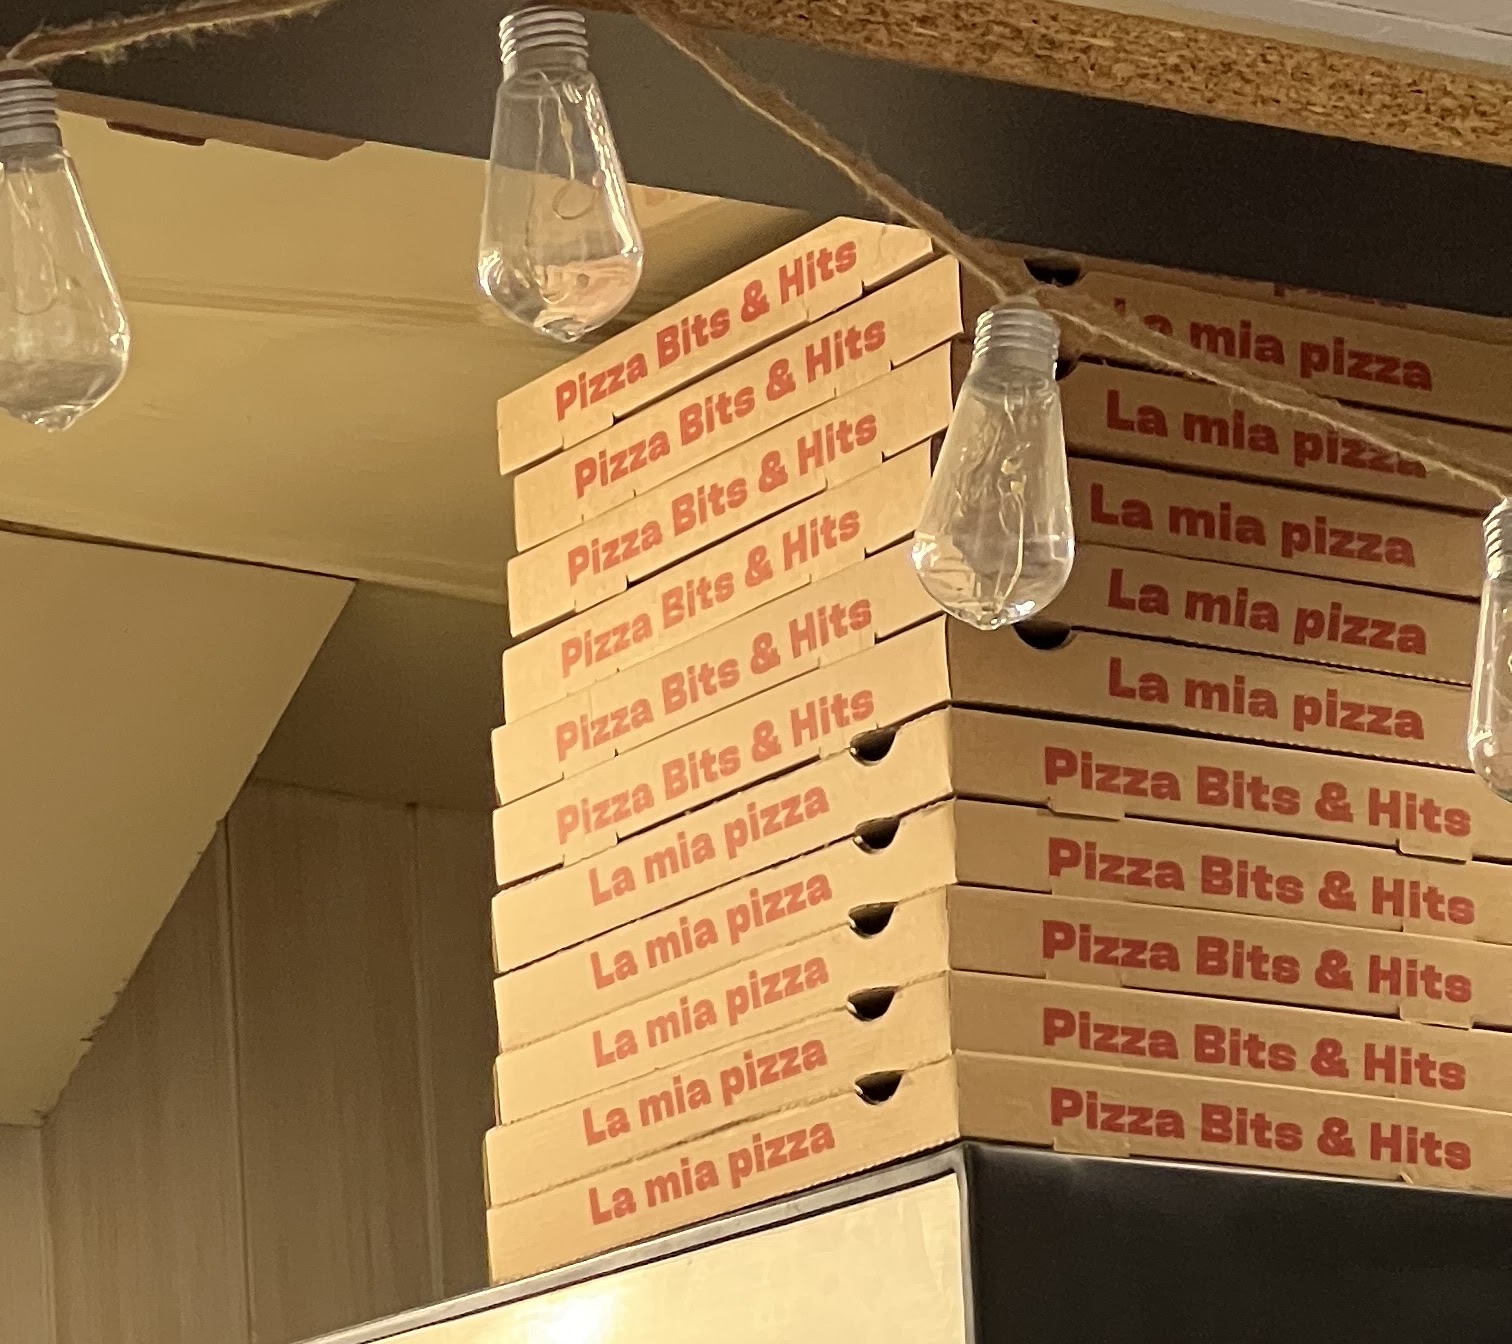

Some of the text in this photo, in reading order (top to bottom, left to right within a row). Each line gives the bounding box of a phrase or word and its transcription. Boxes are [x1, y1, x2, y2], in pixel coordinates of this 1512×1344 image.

[554, 241, 857, 422] Pizza Bits & Hits
[1189, 320, 1433, 391] mia pizza
[573, 320, 886, 498] Pizza Bits & Hits
[1106, 389, 1427, 478] La mia pizza
[567, 414, 878, 586] Pizza Bits & Hits
[1089, 483, 1415, 568] La mia pizza
[561, 510, 860, 677] Pizza Bits & Hits
[1108, 568, 1427, 656] La mia pizza
[555, 599, 873, 761] Pizza Bits & Hits
[1107, 657, 1425, 741] La mia pizza
[556, 689, 875, 845] Pizza Bits & Hits
[1043, 746, 1472, 839] Pizza Bits & Hits
[588, 786, 830, 906] La mia pizza
[1047, 837, 1476, 926] Pizza Bits & Hits
[589, 874, 833, 990] La mia pizza
[1041, 919, 1473, 1005] Pizza Bits & Hits
[592, 958, 830, 1068] La mia pizza
[1041, 1007, 1467, 1093] Pizza Bits & Hits
[583, 1039, 828, 1146] La mia pizza
[1049, 1087, 1472, 1172] Pizza Bits & Hits
[588, 1122, 836, 1226] La mia pizza
